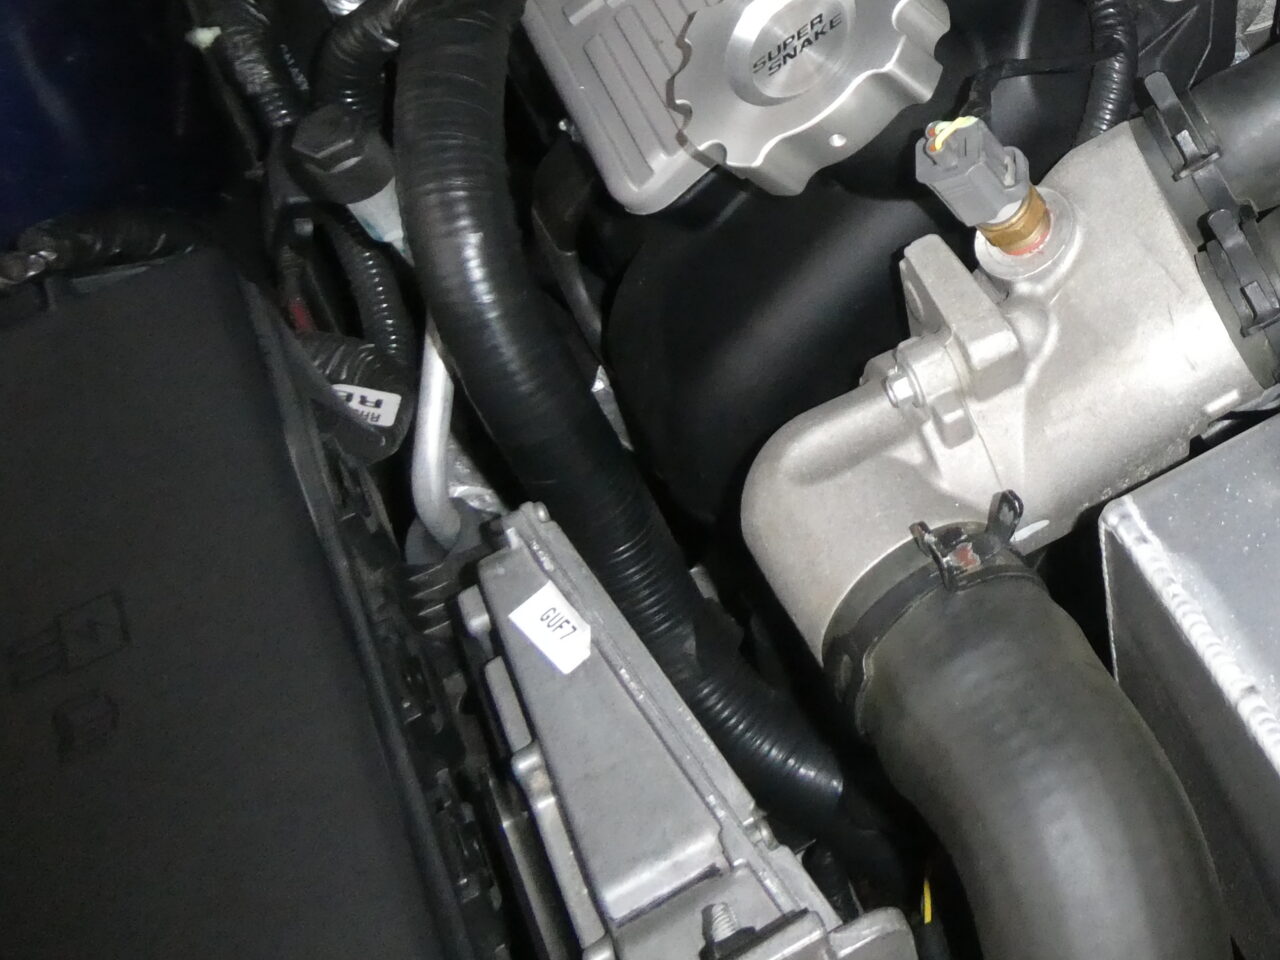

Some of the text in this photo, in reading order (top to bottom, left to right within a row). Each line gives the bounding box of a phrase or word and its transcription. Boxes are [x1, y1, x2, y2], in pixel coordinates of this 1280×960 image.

[752, 12, 824, 74] SUPER
[767, 12, 842, 77] SNAKE
[540, 607, 577, 640] GUF7
